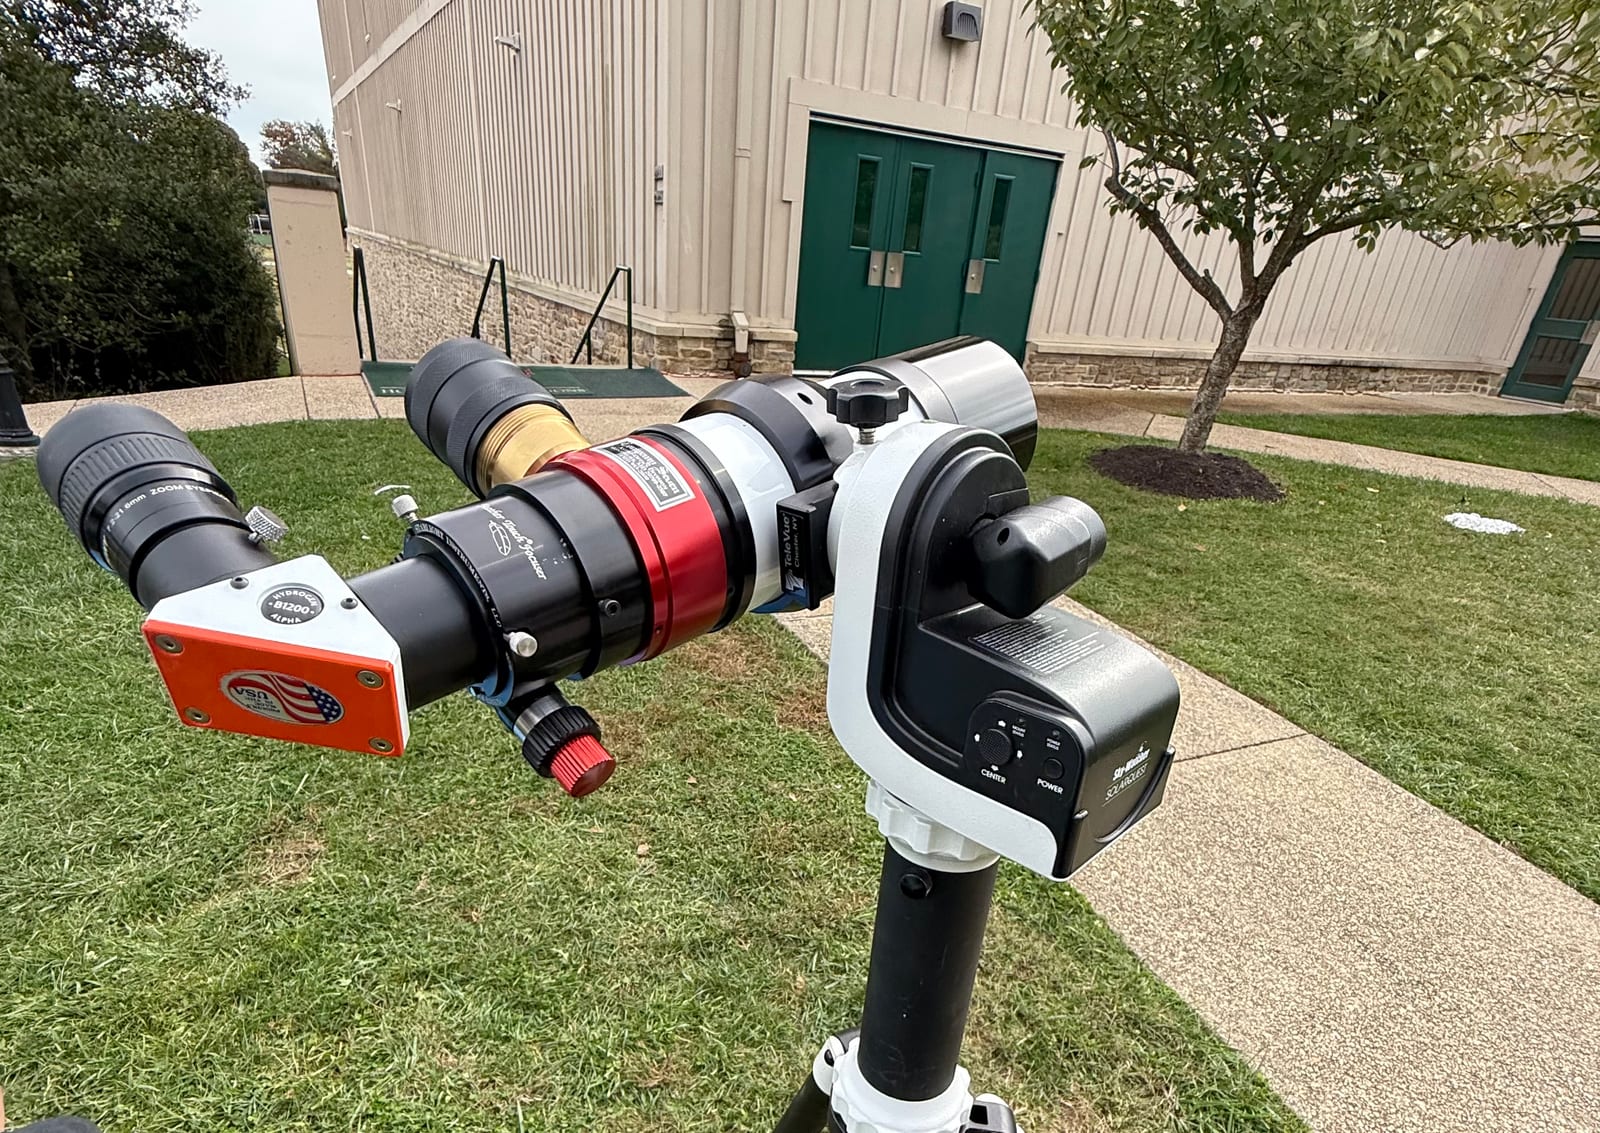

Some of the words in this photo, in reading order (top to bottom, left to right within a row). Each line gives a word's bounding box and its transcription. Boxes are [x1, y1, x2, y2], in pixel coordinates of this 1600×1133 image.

[150, 484, 184, 496] ZOOM
[792, 516, 798, 530] NY
[519, 540, 547, 580] Focuser
[272, 589, 319, 607] HYDROGEN
[273, 600, 311, 615] B1200
[269, 613, 303, 625] ALPHA
[233, 686, 270, 701] USA
[981, 768, 1007, 785] CENTER
[1105, 763, 1149, 801] SOLARQUEST
[1037, 778, 1064, 795] POWER
